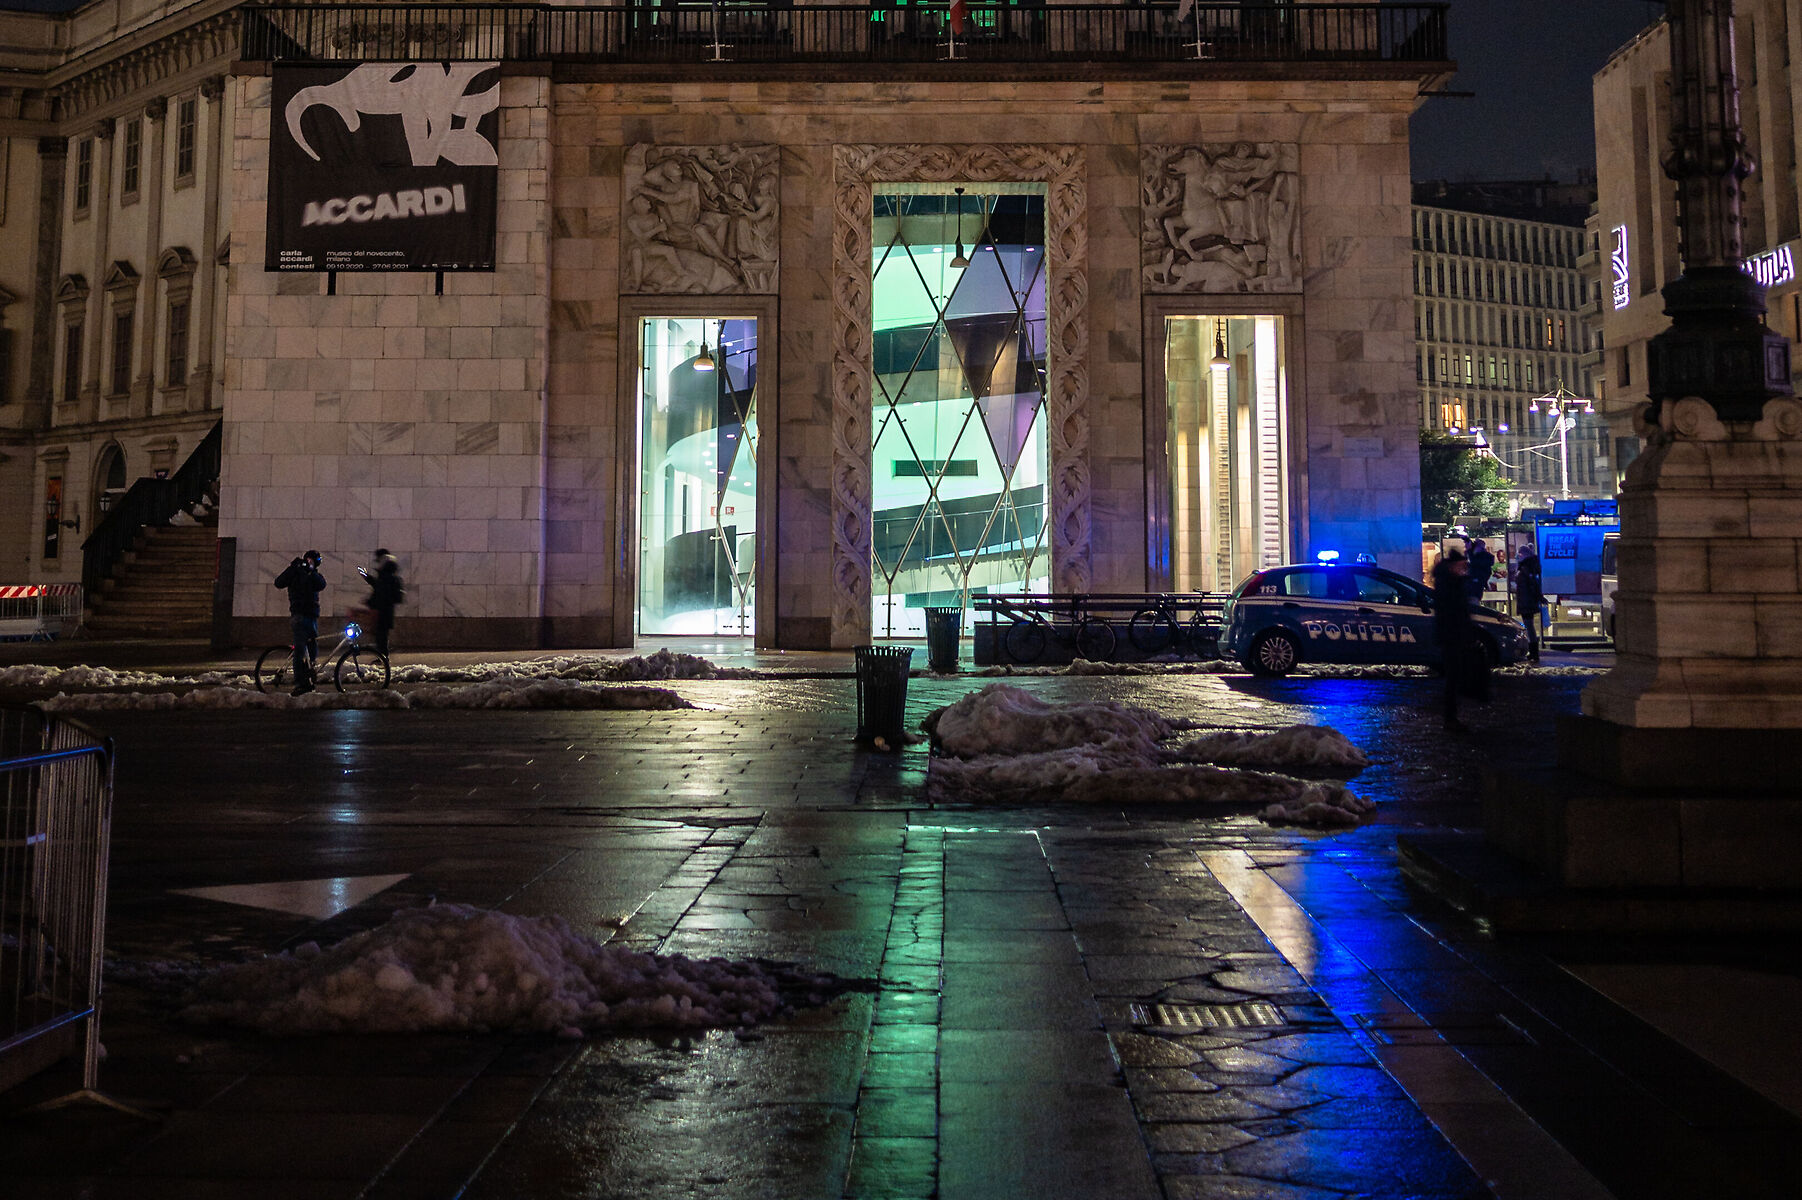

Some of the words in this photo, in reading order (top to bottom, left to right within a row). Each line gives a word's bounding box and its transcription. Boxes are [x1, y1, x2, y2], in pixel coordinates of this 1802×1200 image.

[302, 184, 466, 227] ACCARDI
[1260, 585, 1277, 593] 113
[1307, 622, 1417, 644] POLIZIA
